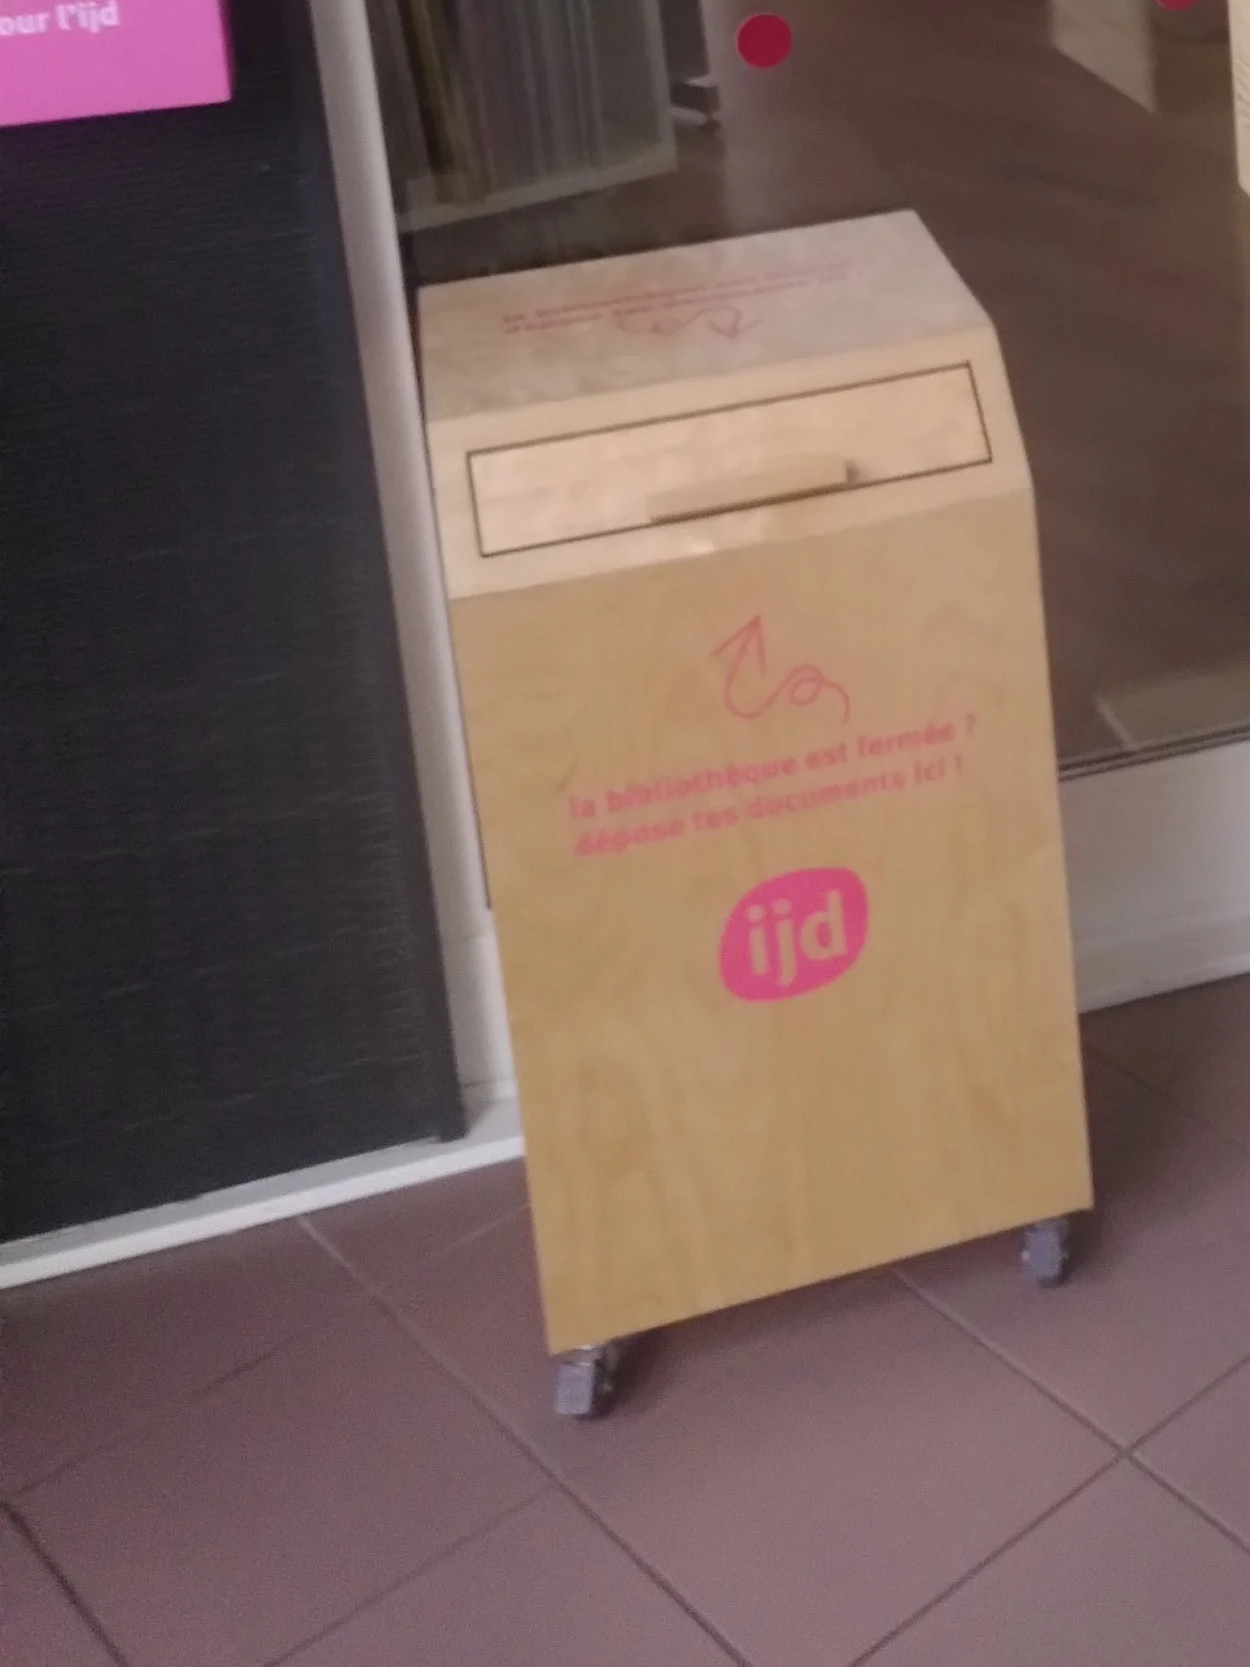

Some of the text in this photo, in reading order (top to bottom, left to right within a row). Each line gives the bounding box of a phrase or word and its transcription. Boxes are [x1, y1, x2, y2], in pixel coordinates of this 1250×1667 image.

[0, 11, 50, 36] our
[574, 816, 687, 857] dépose
[692, 804, 740, 833] tes
[745, 768, 908, 821] documents
[913, 755, 947, 786] ici
[605, 754, 799, 813] bibliothèque
[804, 741, 849, 771] est
[856, 718, 958, 759] fermée
[746, 888, 849, 988] ijd
